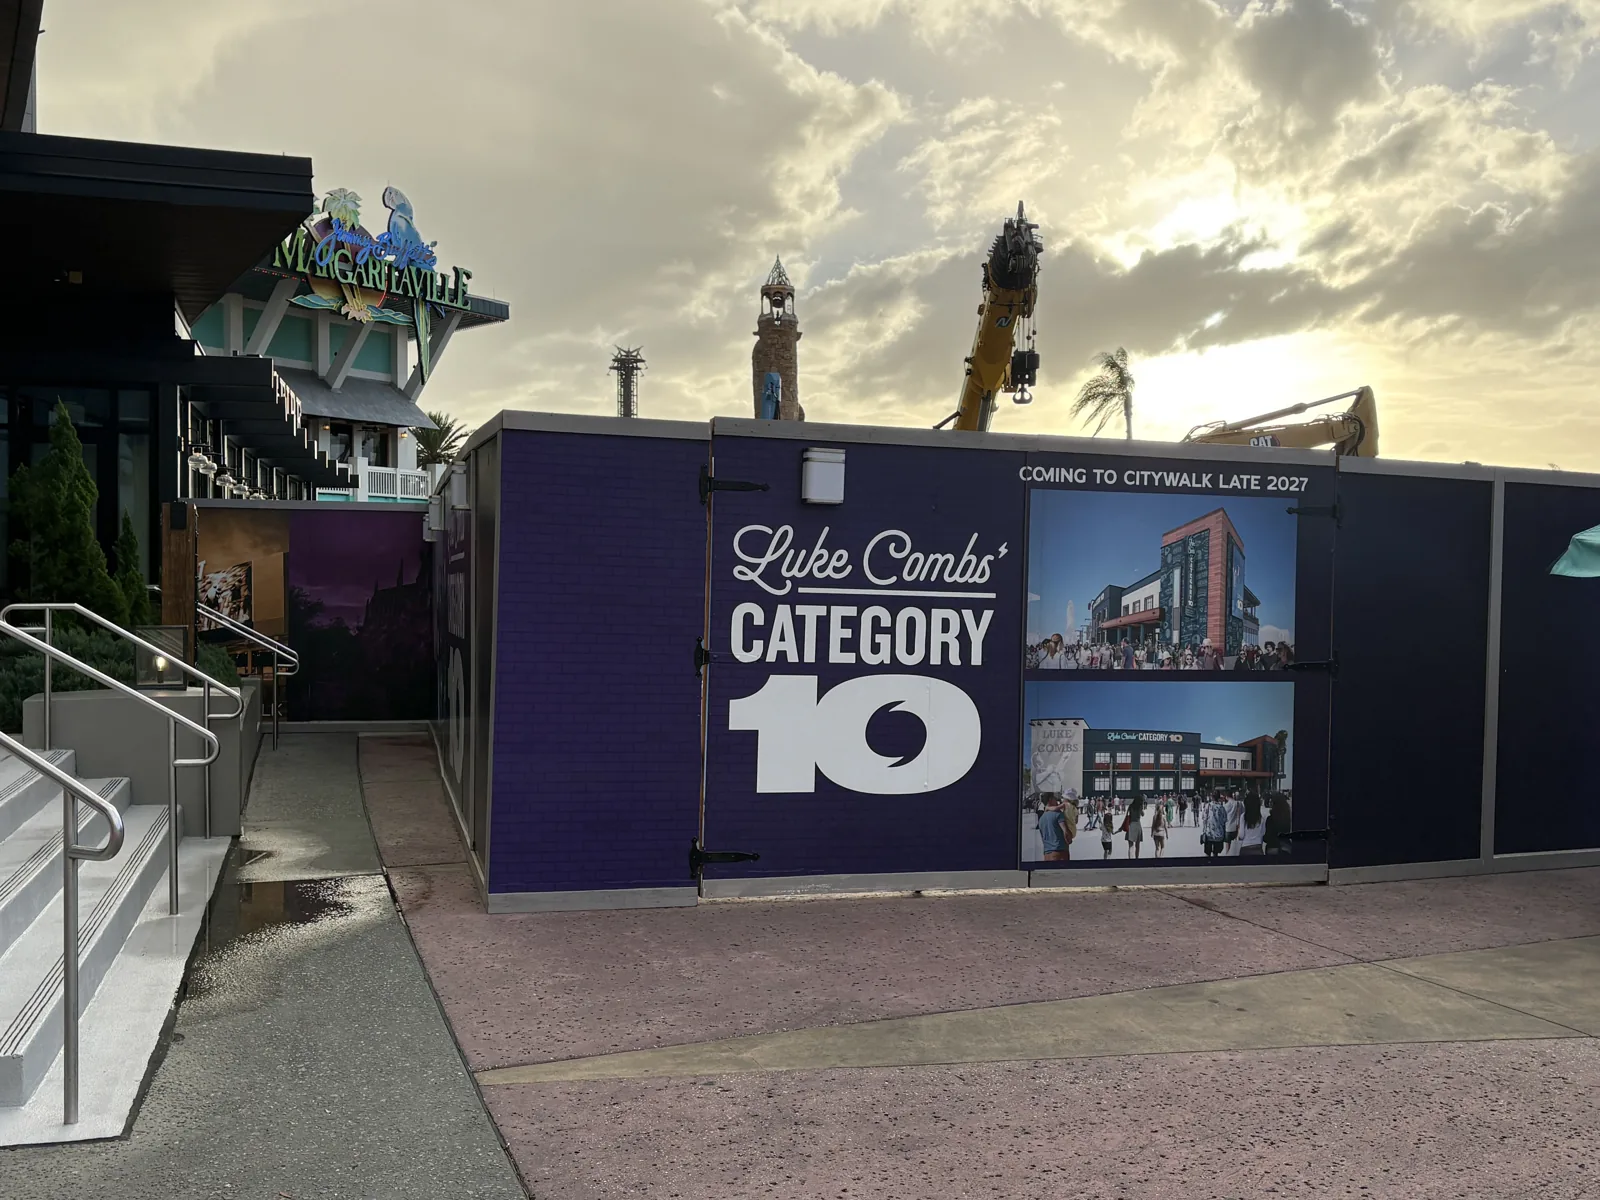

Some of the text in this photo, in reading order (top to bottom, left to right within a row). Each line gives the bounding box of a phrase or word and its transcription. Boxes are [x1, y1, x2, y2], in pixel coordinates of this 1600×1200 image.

[272, 227, 473, 310] MARGARITAVILLE
[1249, 435, 1273, 447] CAT
[1019, 466, 1309, 492] COMING TO CITYWALK LATE 2027
[732, 524, 853, 596] Luke
[731, 602, 995, 666] CATEGORY
[728, 674, 982, 795] 10
[1042, 729, 1072, 739] LUKE
[1138, 732, 1168, 742] CATEGORY
[1037, 743, 1079, 753] COMBS
